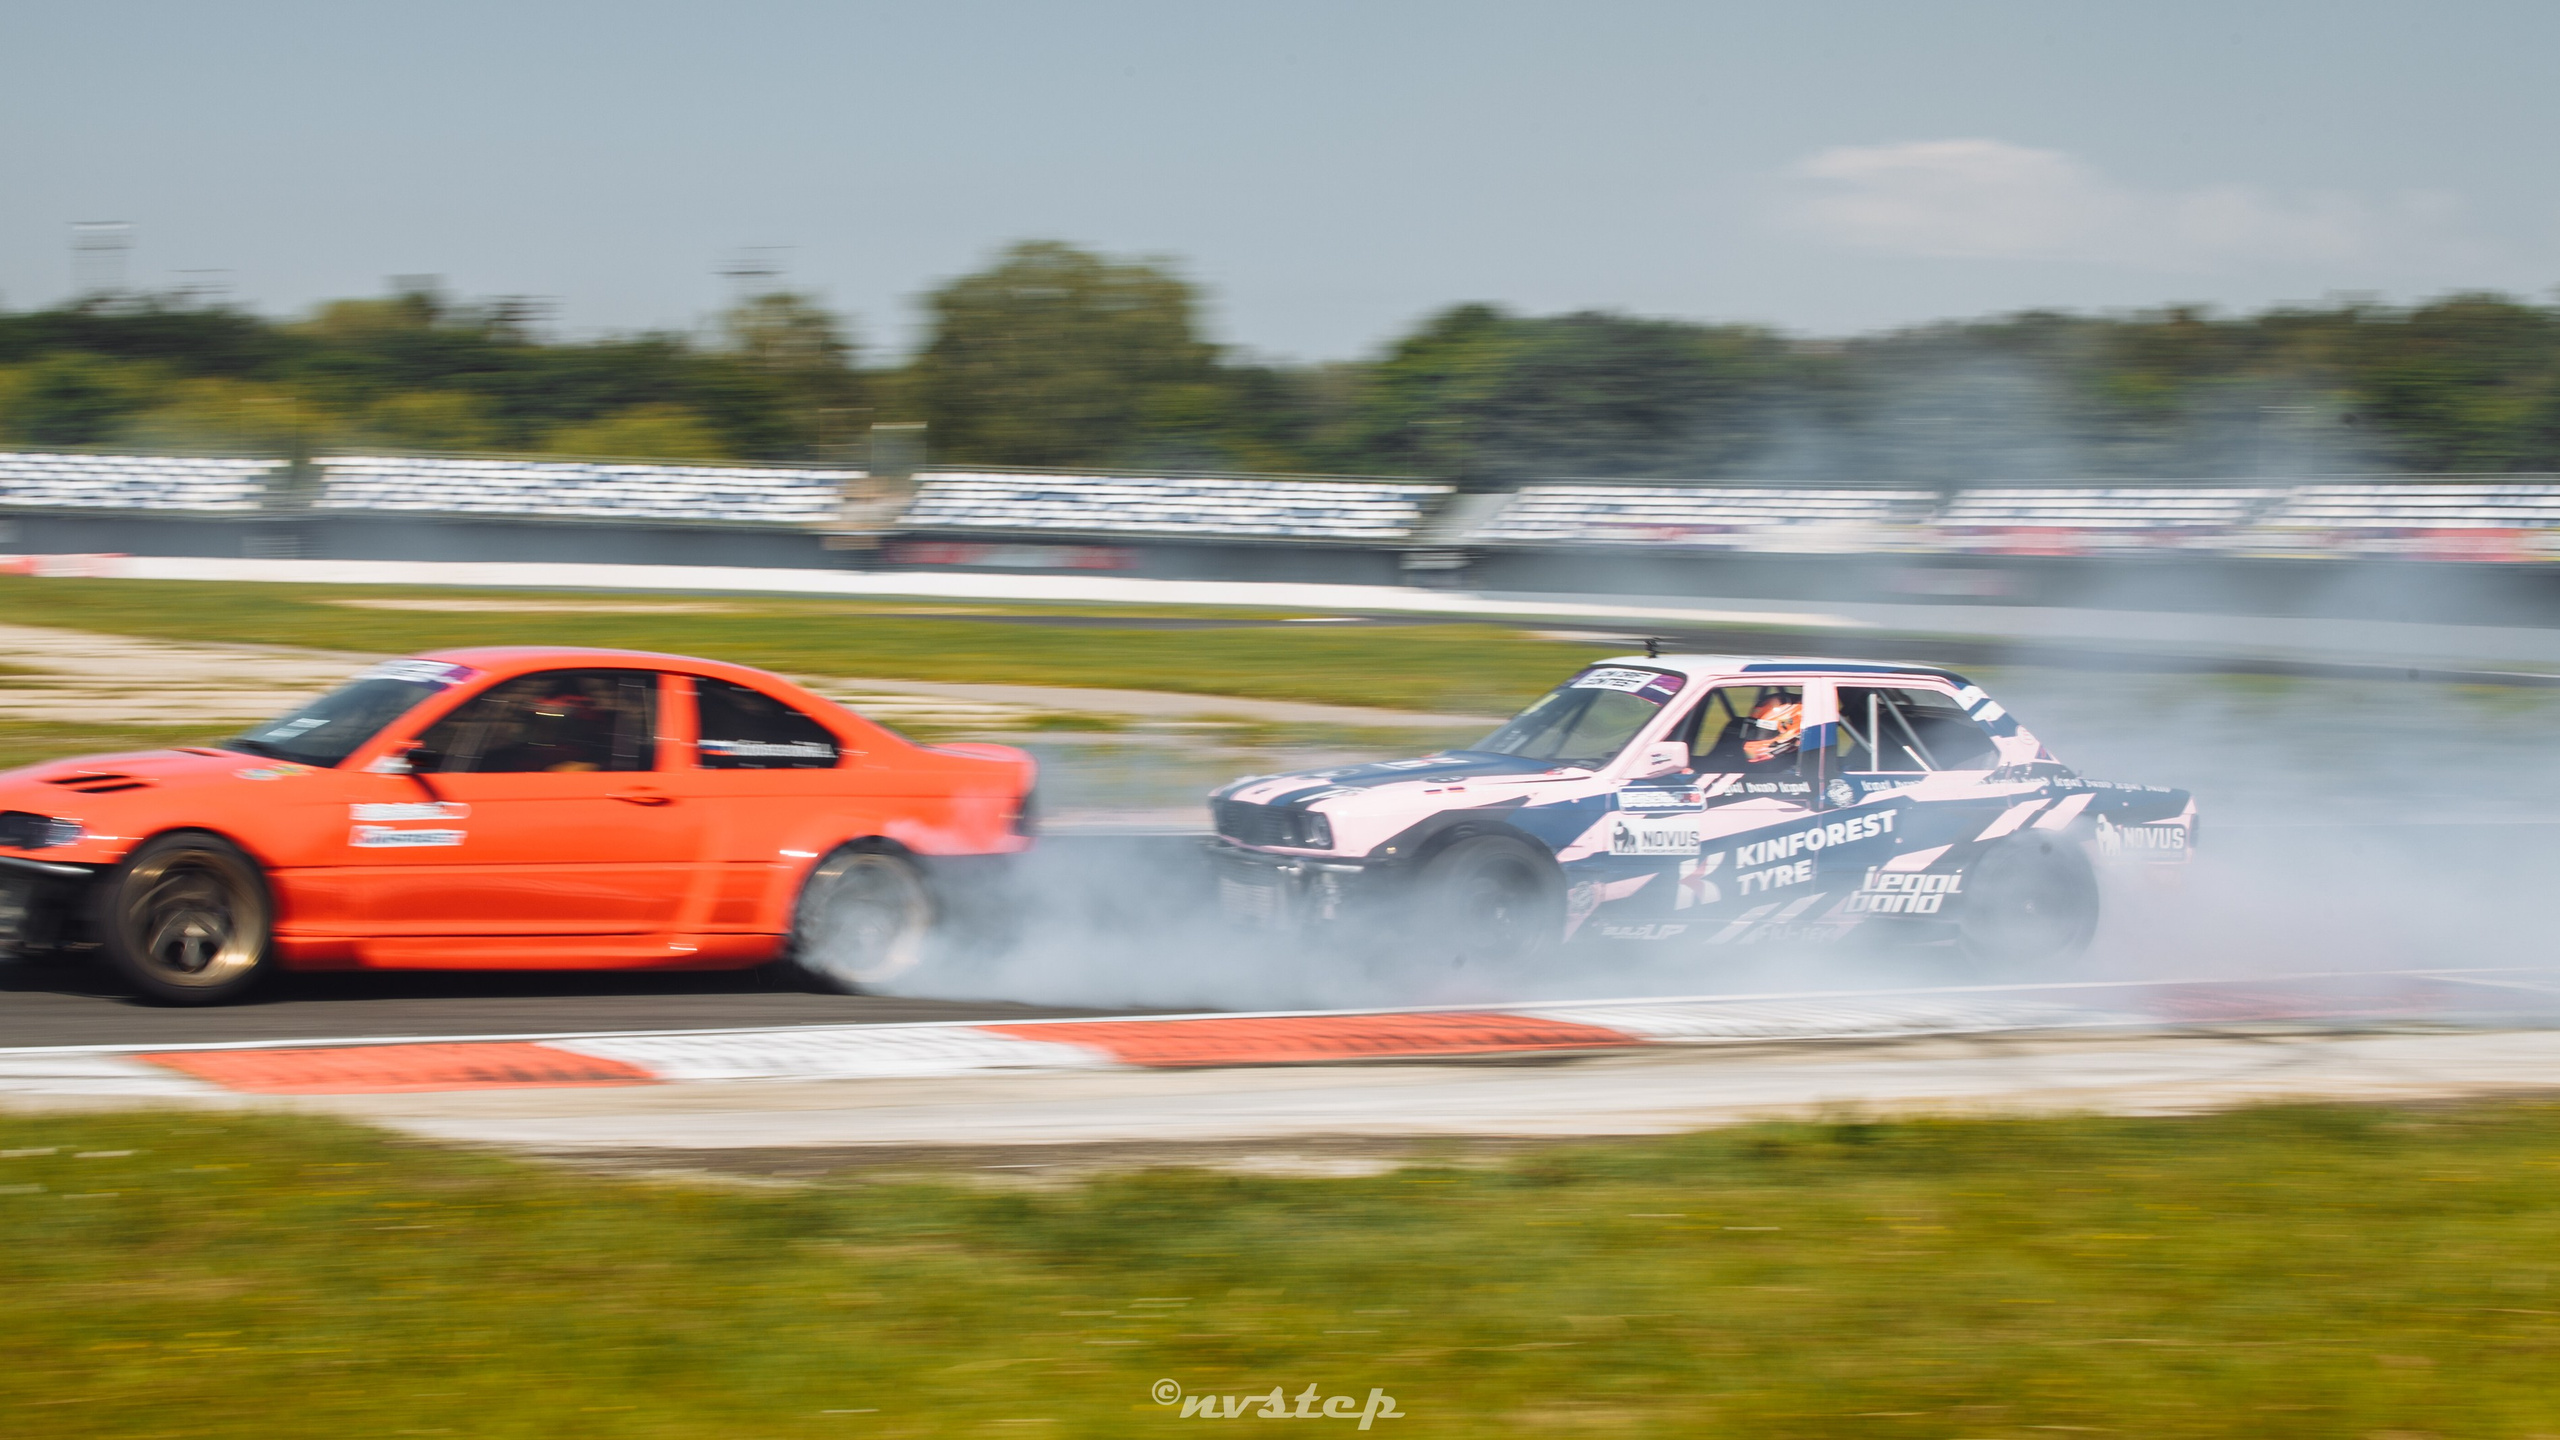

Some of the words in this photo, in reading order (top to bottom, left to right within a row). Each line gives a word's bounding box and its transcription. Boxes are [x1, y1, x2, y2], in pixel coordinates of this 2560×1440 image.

[1641, 830, 1700, 847] NOVUS
[1736, 809, 1897, 869] KINFOREST
[2123, 827, 2185, 849] NOVUS
[1736, 859, 1812, 896] TYRE
